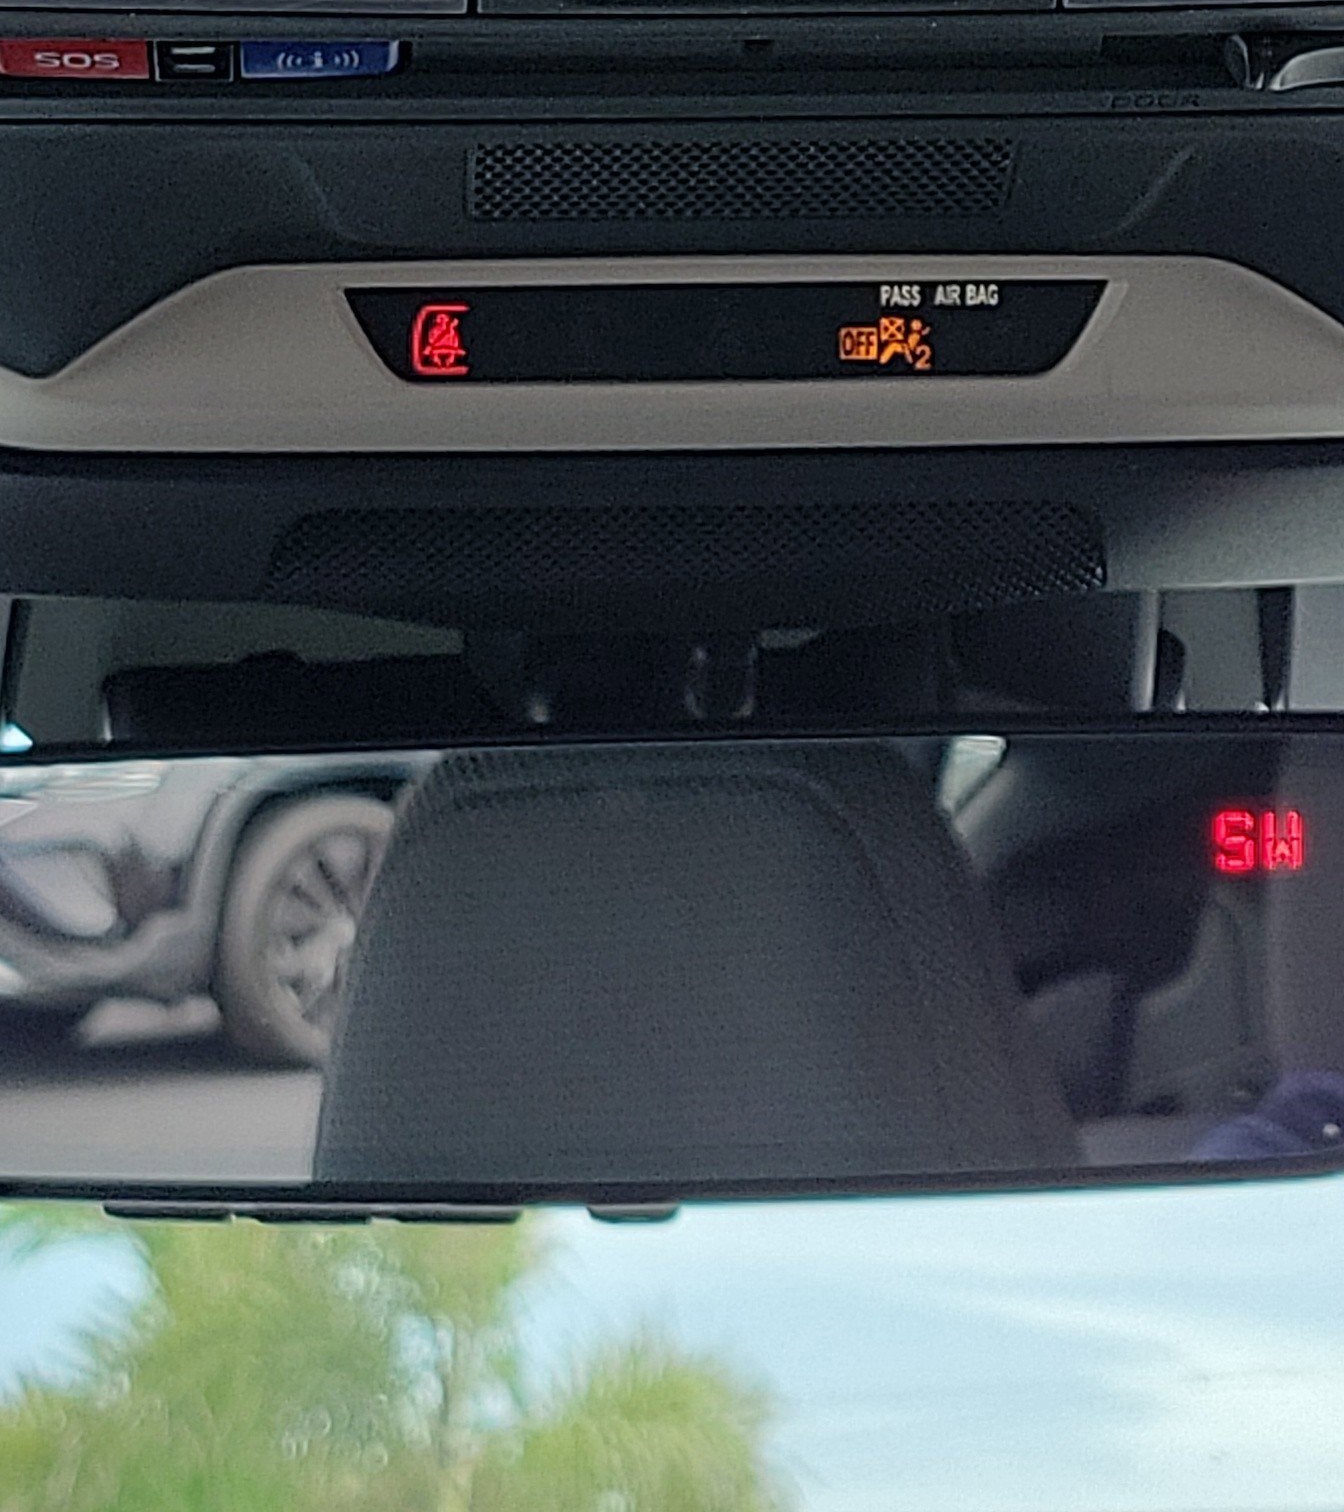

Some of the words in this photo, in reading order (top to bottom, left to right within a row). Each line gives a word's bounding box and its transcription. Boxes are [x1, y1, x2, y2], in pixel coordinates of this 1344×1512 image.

[34, 51, 120, 71] SOS
[879, 284, 922, 308] PASS
[933, 284, 962, 307] AIR
[964, 283, 1000, 307] BAG
[841, 328, 876, 358] OFF
[914, 344, 933, 370] 2
[1213, 810, 1304, 871] SW
